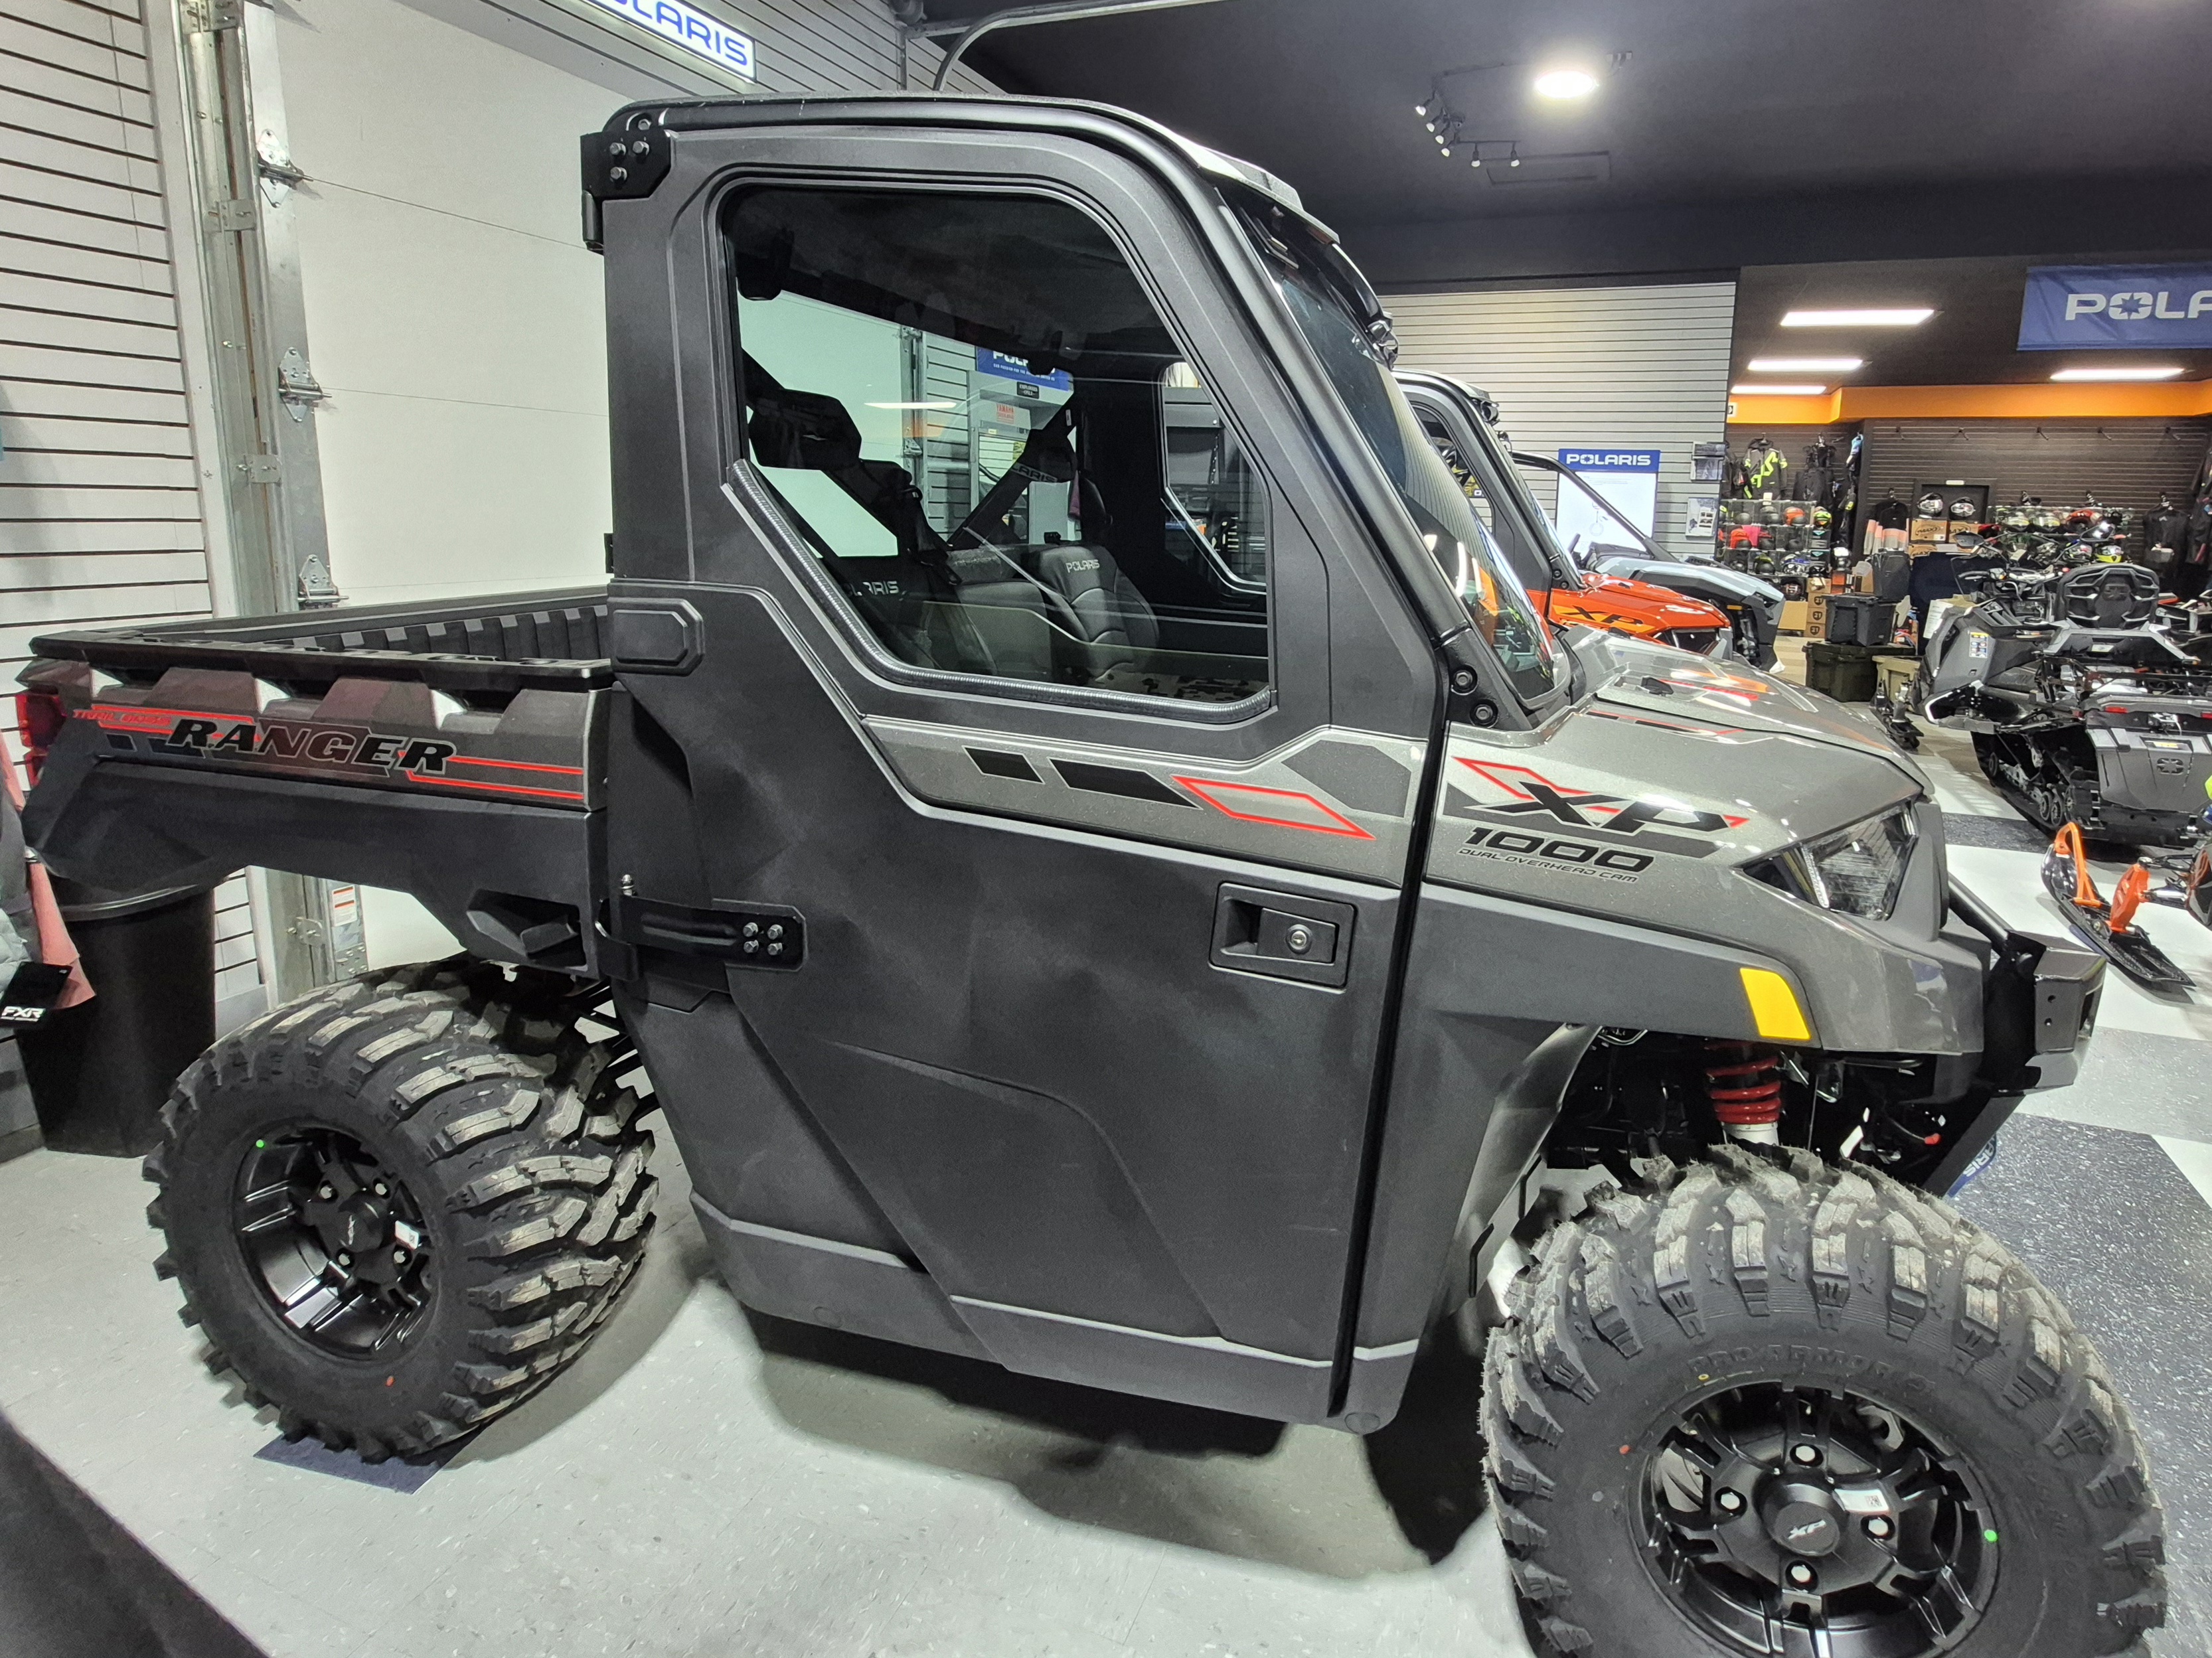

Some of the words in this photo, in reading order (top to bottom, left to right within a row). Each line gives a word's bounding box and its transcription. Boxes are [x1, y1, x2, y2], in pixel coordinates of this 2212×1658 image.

[612, 0, 748, 66] LARIS
[1566, 453, 1652, 467] POLARIS
[1066, 559, 1100, 573] POLARIS
[165, 717, 458, 775] RANGER
[1475, 780, 1731, 834] XP
[1459, 848, 1501, 862] DUAL
[1504, 856, 1597, 875] OVERHEAD
[1598, 871, 1639, 883] CAM
[1464, 826, 1654, 873] 1000
[1, 1006, 46, 1018] FXR
